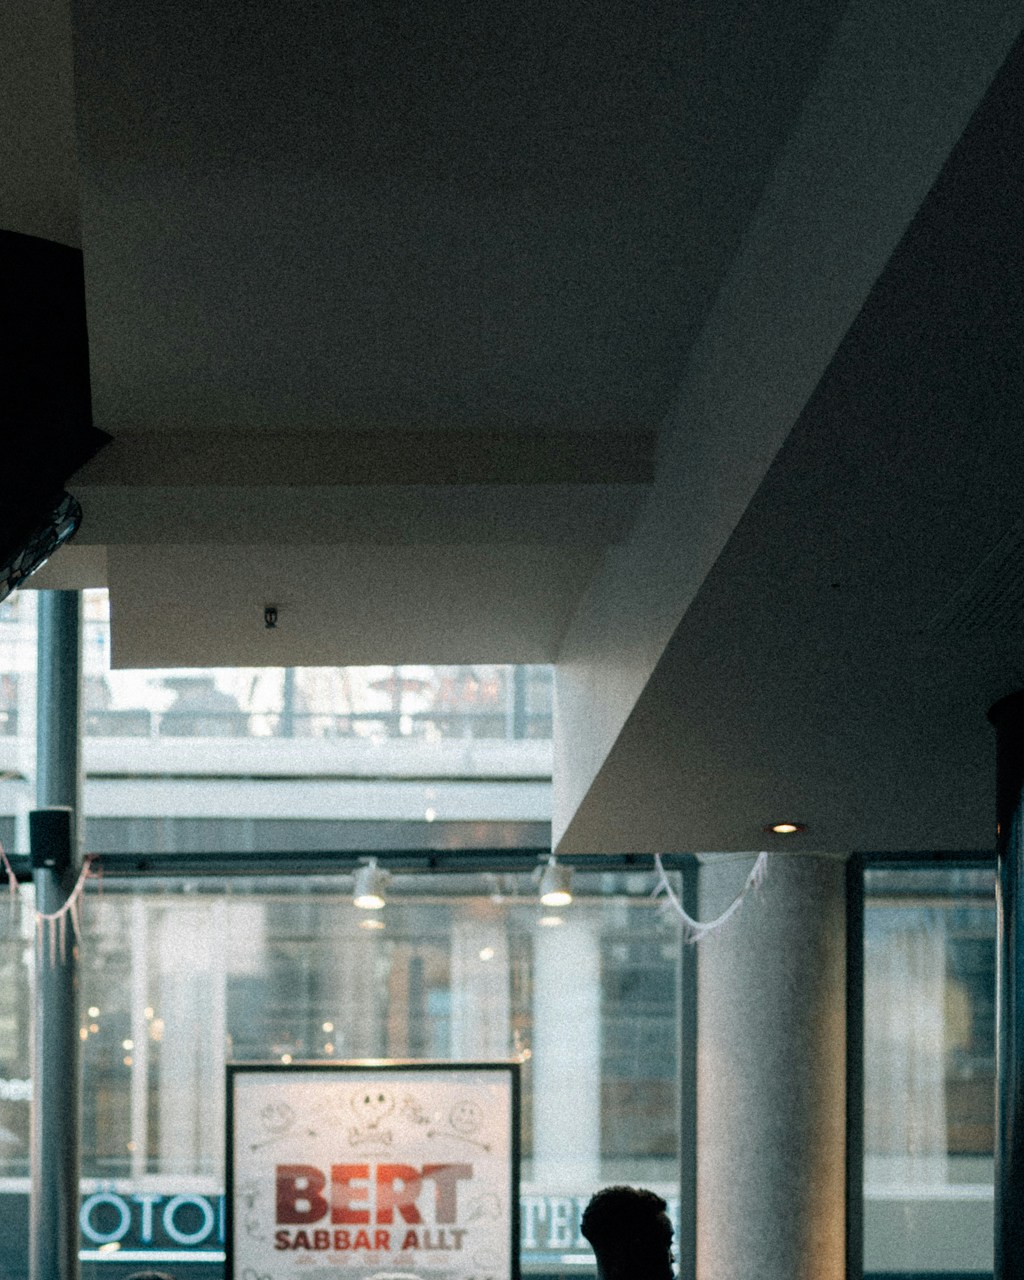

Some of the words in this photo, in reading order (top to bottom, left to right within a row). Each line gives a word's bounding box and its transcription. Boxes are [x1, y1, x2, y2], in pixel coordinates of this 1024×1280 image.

[275, 1163, 473, 1225] BERT
[274, 1229, 392, 1251] SABBAR
[401, 1229, 468, 1251] ALLT
